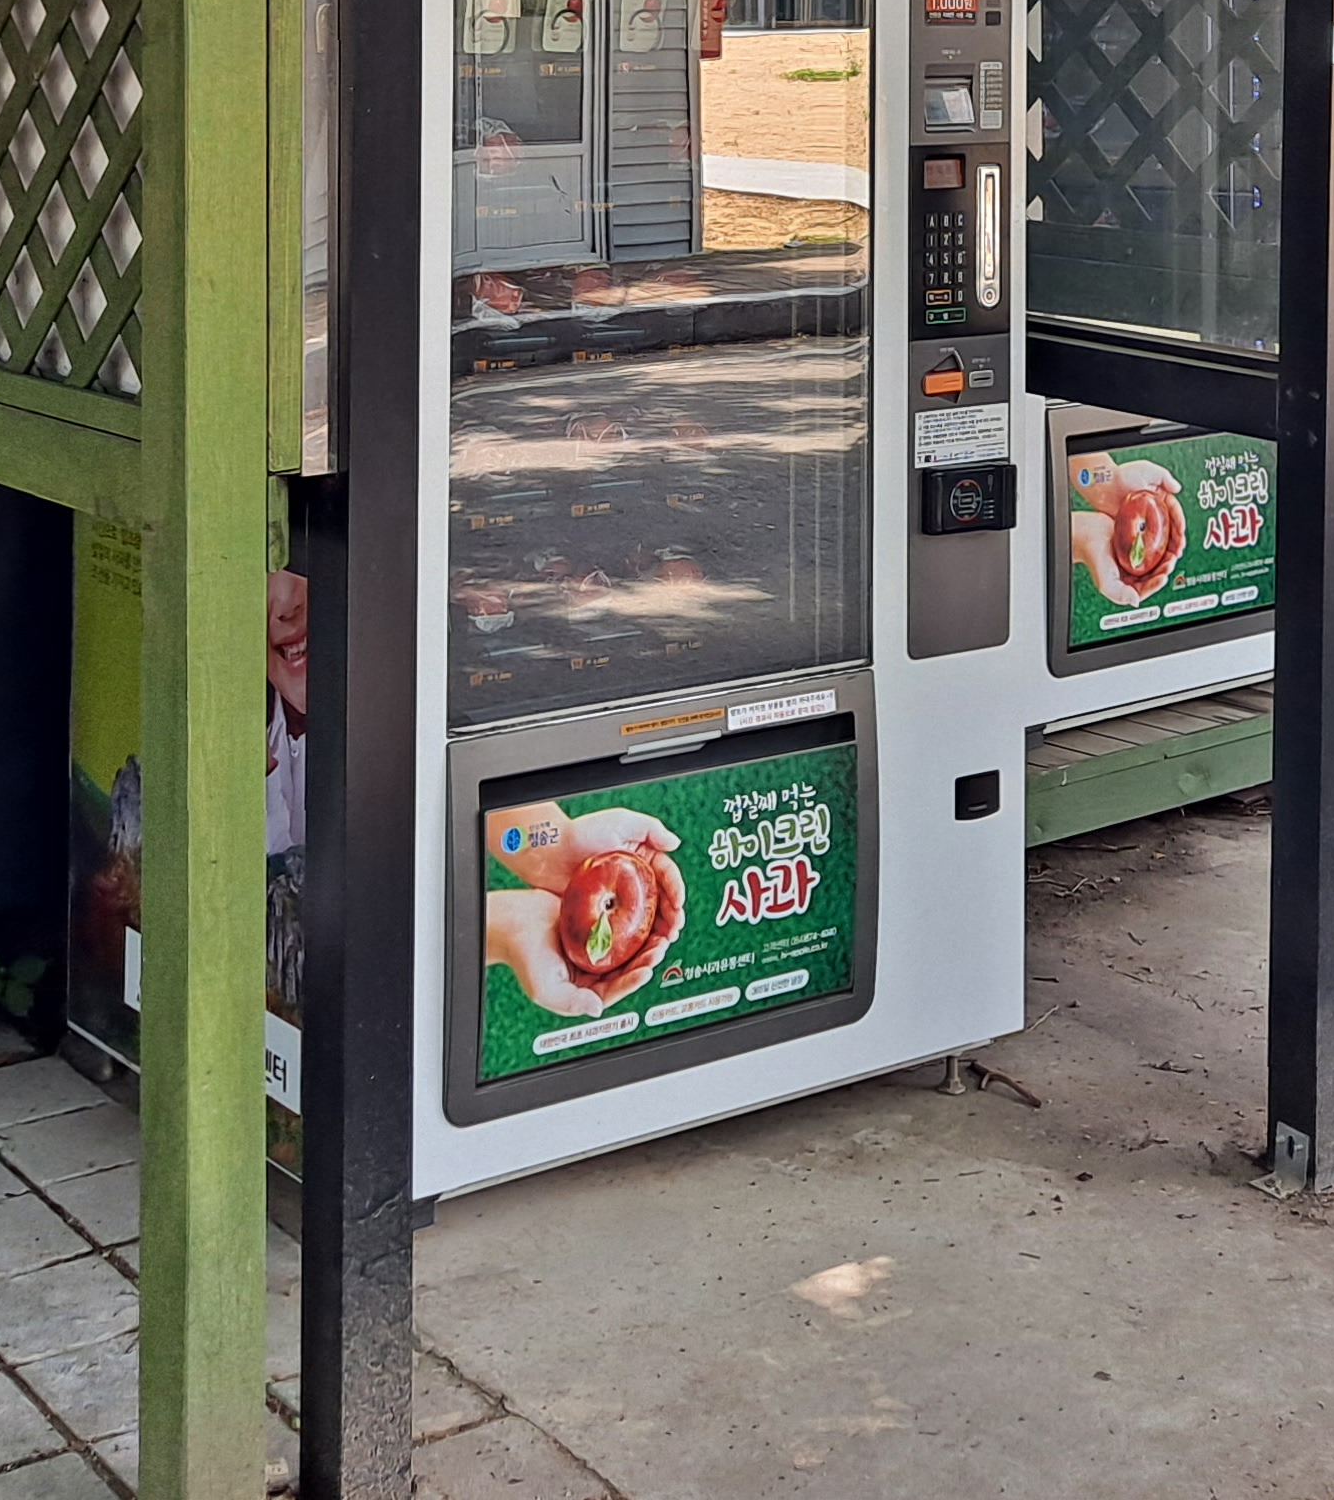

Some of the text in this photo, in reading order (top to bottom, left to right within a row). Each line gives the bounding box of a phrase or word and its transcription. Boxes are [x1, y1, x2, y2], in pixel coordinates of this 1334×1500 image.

[1238, 450, 1259, 471] 먹는
[1197, 467, 1268, 509] 하이크린
[1203, 503, 1264, 550] 사과
[723, 781, 816, 823] 껍질째 먹는
[708, 803, 830, 870] 하이크린
[715, 854, 821, 927] 사과
